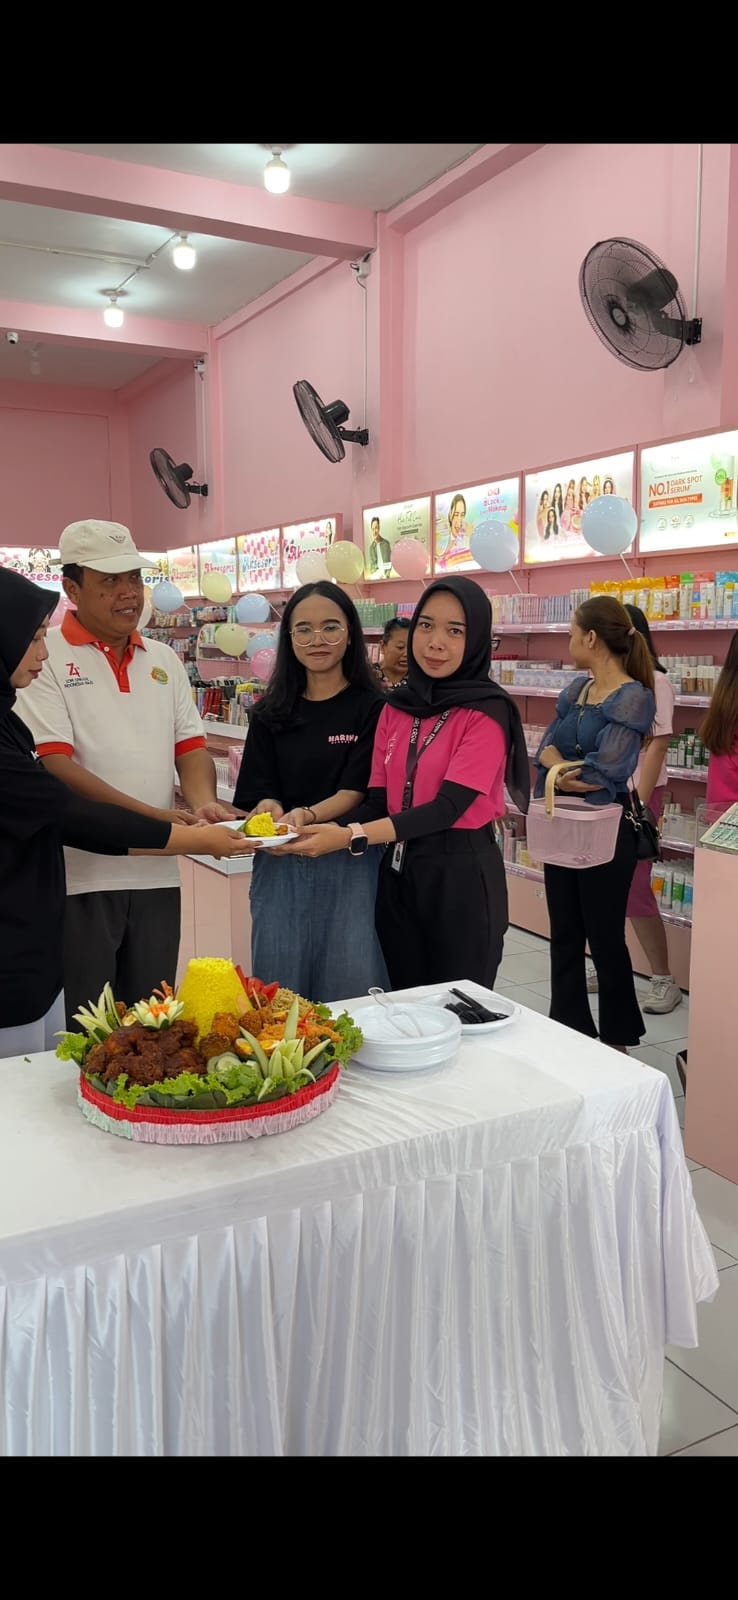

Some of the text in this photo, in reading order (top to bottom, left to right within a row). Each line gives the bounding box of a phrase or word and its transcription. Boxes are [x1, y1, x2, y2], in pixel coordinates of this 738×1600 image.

[671, 478, 686, 487] DARK
[687, 474, 703, 484] SPOT
[648, 480, 670, 497] NO.1
